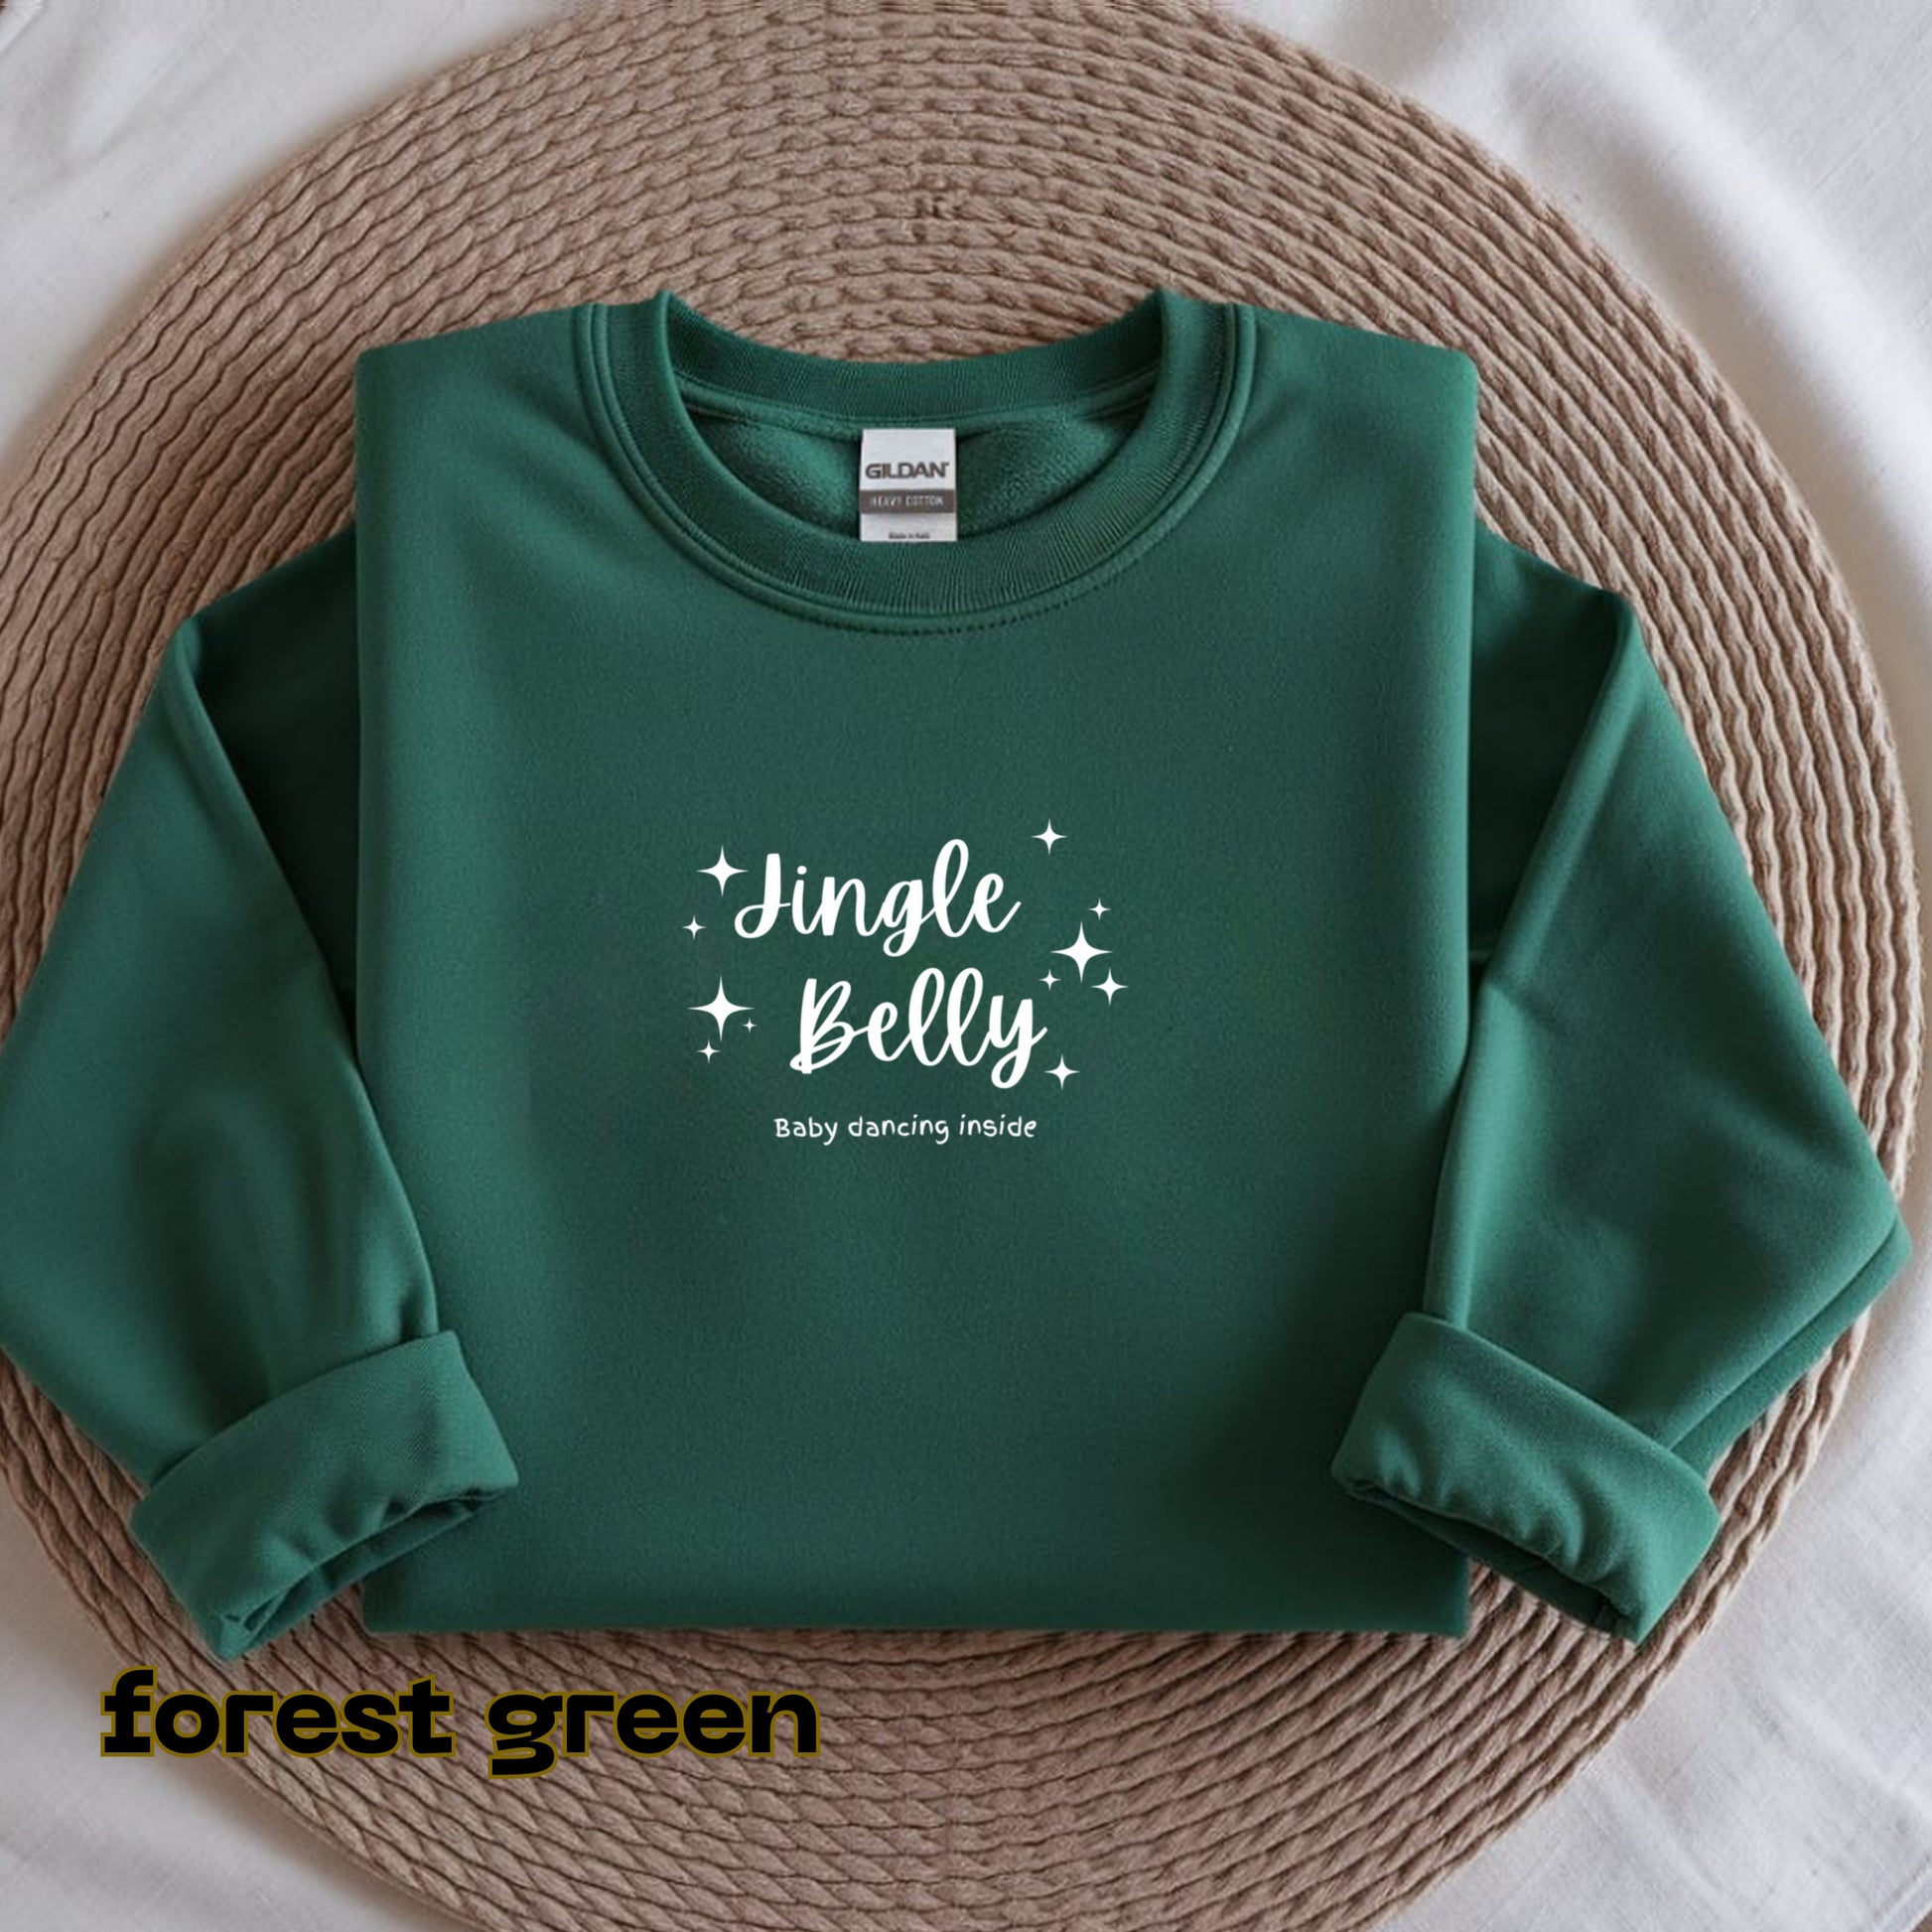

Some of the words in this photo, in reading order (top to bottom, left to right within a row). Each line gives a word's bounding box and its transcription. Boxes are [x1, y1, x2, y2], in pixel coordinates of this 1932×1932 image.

[865, 461, 950, 479] GILDAN
[734, 839, 1022, 957] Jingle
[789, 967, 1047, 1089] Belly
[773, 1116, 838, 1146] Baby
[848, 1114, 949, 1145] dancing
[959, 1114, 1037, 1138] inside
